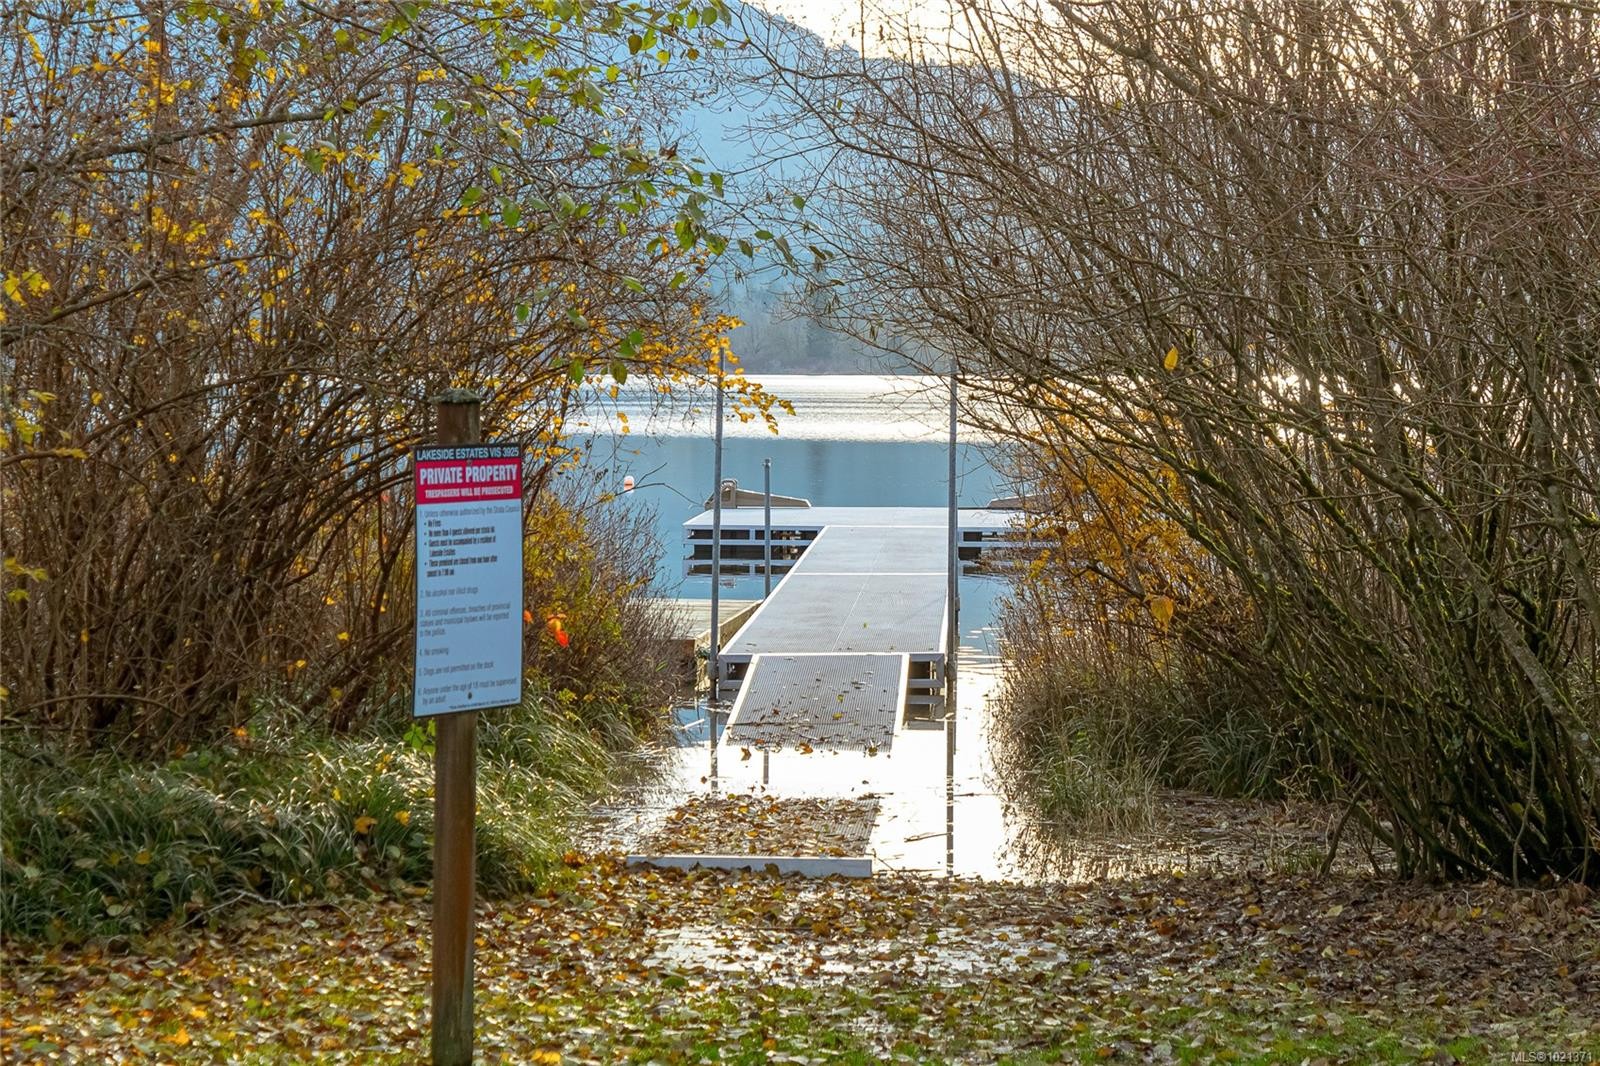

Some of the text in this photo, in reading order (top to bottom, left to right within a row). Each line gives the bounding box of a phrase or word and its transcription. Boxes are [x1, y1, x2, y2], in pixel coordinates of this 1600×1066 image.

[417, 447, 519, 460] LAKESIDE ESTATES VIS 3925
[420, 464, 517, 484] PRIVATE PROPERTY
[425, 488, 459, 498] TRESPASSERS
[482, 486, 513, 494] PROSECUTED
